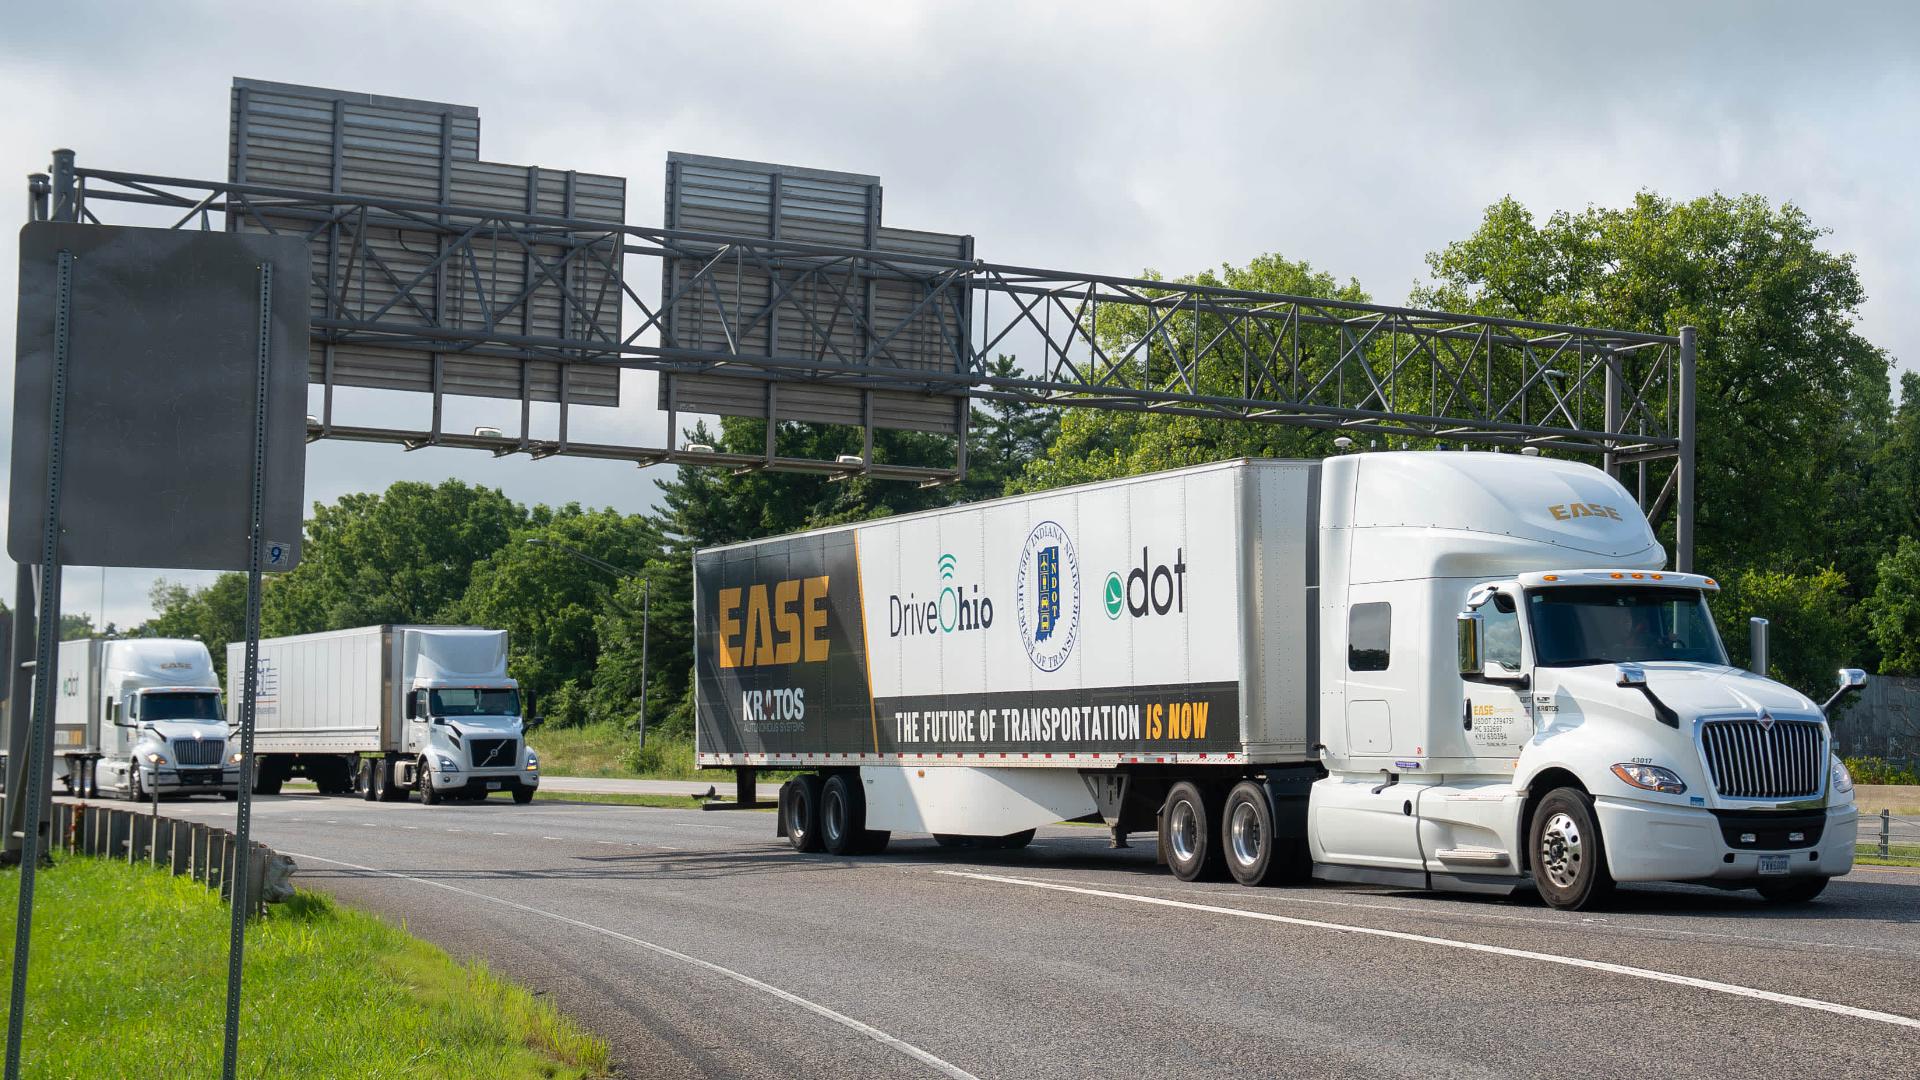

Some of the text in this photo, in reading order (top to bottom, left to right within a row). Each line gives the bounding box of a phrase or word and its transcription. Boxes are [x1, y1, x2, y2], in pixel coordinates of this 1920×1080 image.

[1548, 503, 1623, 521] EASE
[1031, 526, 1062, 547] INDIANA
[719, 576, 830, 668] EASE
[890, 584, 993, 637] DriveOhio
[1036, 652, 1046, 667] OF
[743, 688, 804, 720] KRATOS
[1473, 705, 1493, 715] EASE
[895, 702, 1209, 742] THE FUTURE OF TRANSPORTATION IS NOW
